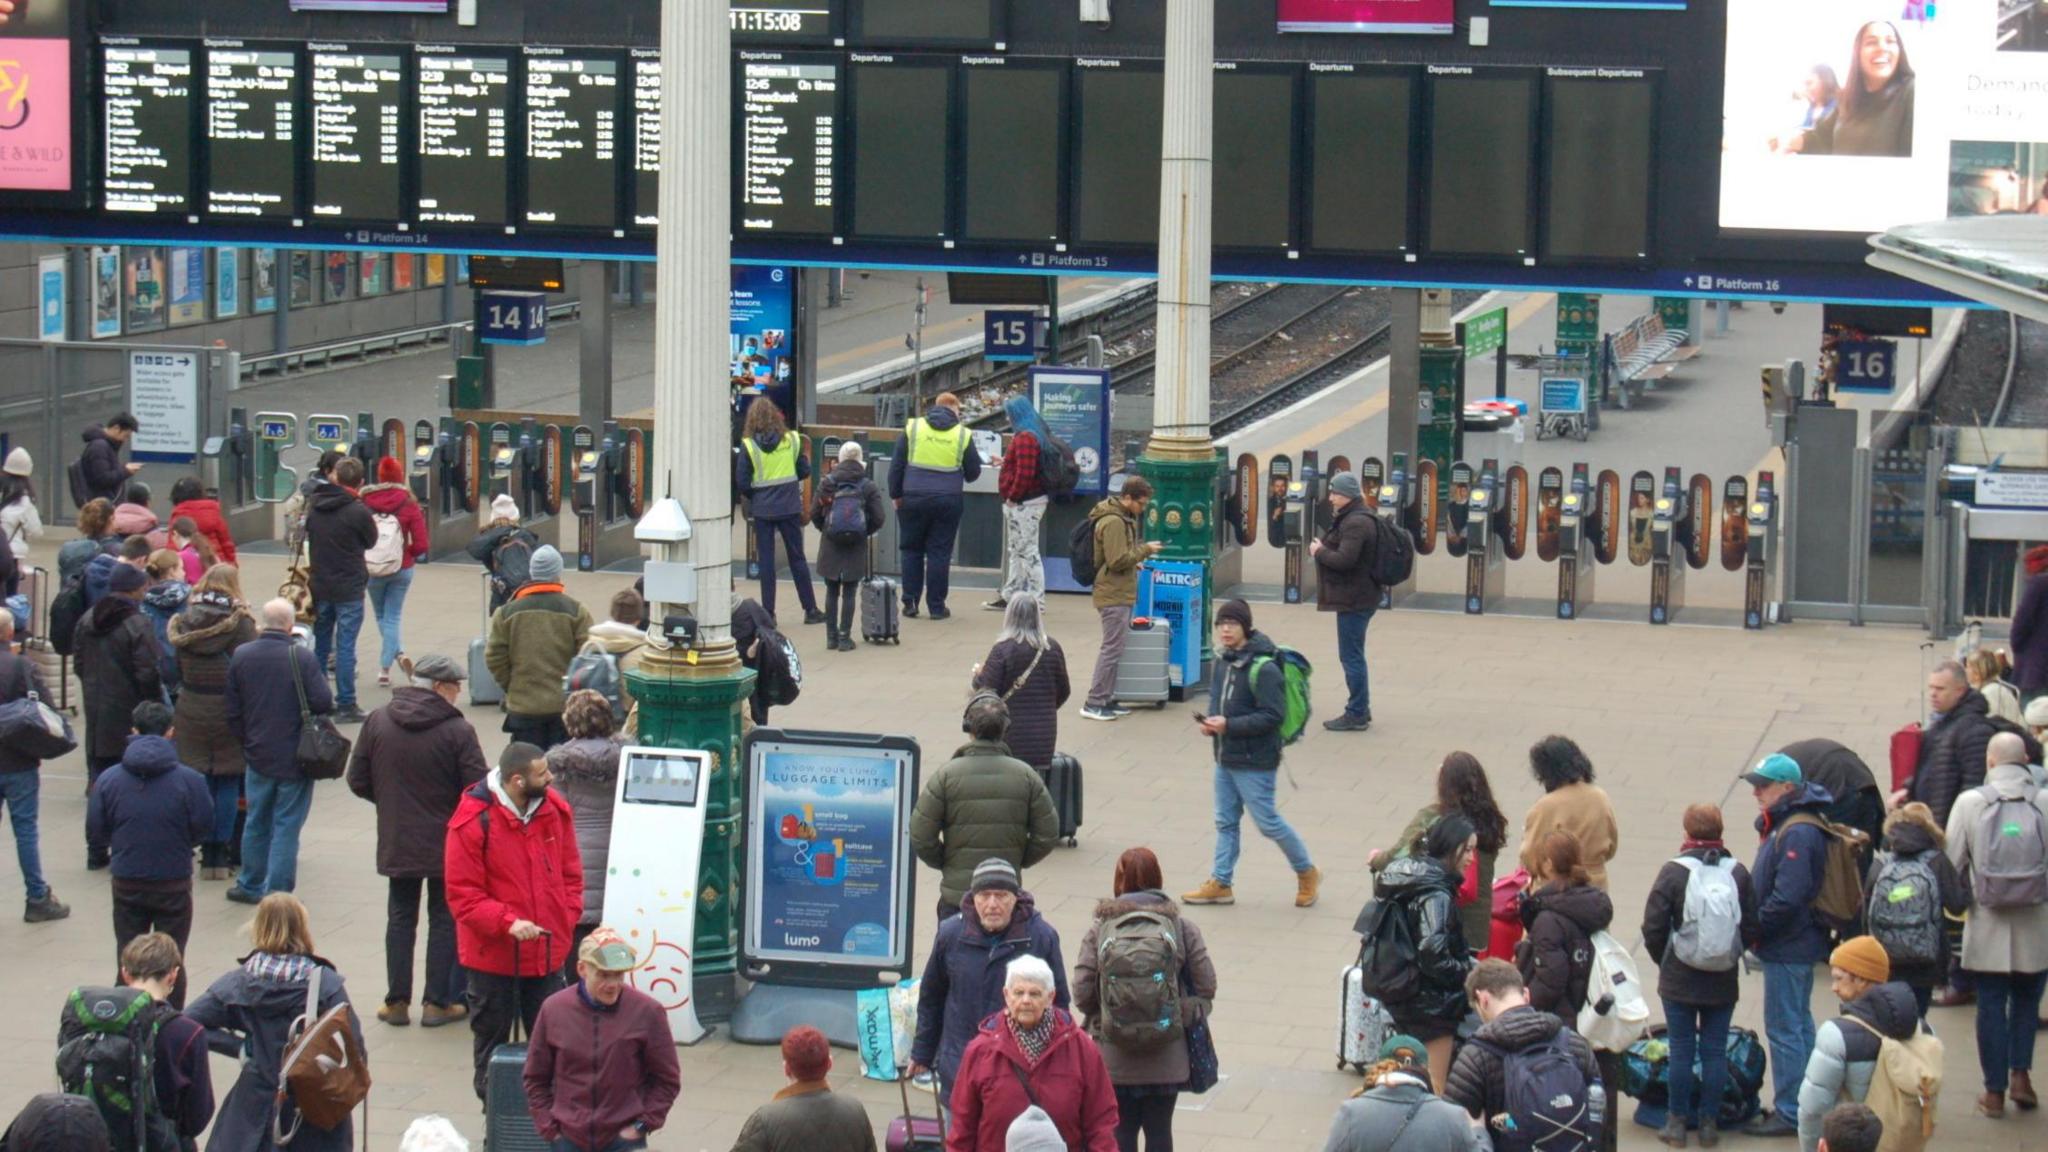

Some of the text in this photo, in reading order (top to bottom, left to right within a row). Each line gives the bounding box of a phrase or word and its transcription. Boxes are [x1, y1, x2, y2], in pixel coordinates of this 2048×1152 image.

[729, 12, 801, 31] 11:15:08
[204, 39, 244, 48] Departures
[308, 43, 348, 52] Departures
[415, 44, 456, 53] Departures
[523, 47, 564, 56] Departures
[740, 52, 782, 60] Departures
[851, 54, 893, 63] Departures
[962, 56, 1005, 65] Departures
[1077, 58, 1120, 68] Departures
[528, 59, 570, 72] Platform
[745, 64, 789, 77] Platform
[1309, 62, 1354, 72] Departures
[1428, 65, 1473, 75] Departures
[1547, 67, 1643, 79] Subsequent Departures
[578, 74, 593, 86] On
[797, 79, 812, 91] On
[813, 80, 836, 91] time
[745, 90, 798, 103] Tweedbank
[27, 147, 63, 162] WILD
[372, 233, 428, 244] Platform 14
[1048, 254, 1108, 267] Platform 15
[1716, 278, 1780, 291] Platform 16
[489, 305, 545, 330] 14 14
[992, 320, 1027, 346] 15
[1847, 350, 1884, 378] 16
[1044, 393, 1072, 404] Making
[1043, 401, 1097, 413] journeys safer
[784, 764, 878, 776] KNOW YOUR LUMO
[772, 773, 889, 788] LUGGAGE LIMITS
[784, 932, 821, 947] lumo
